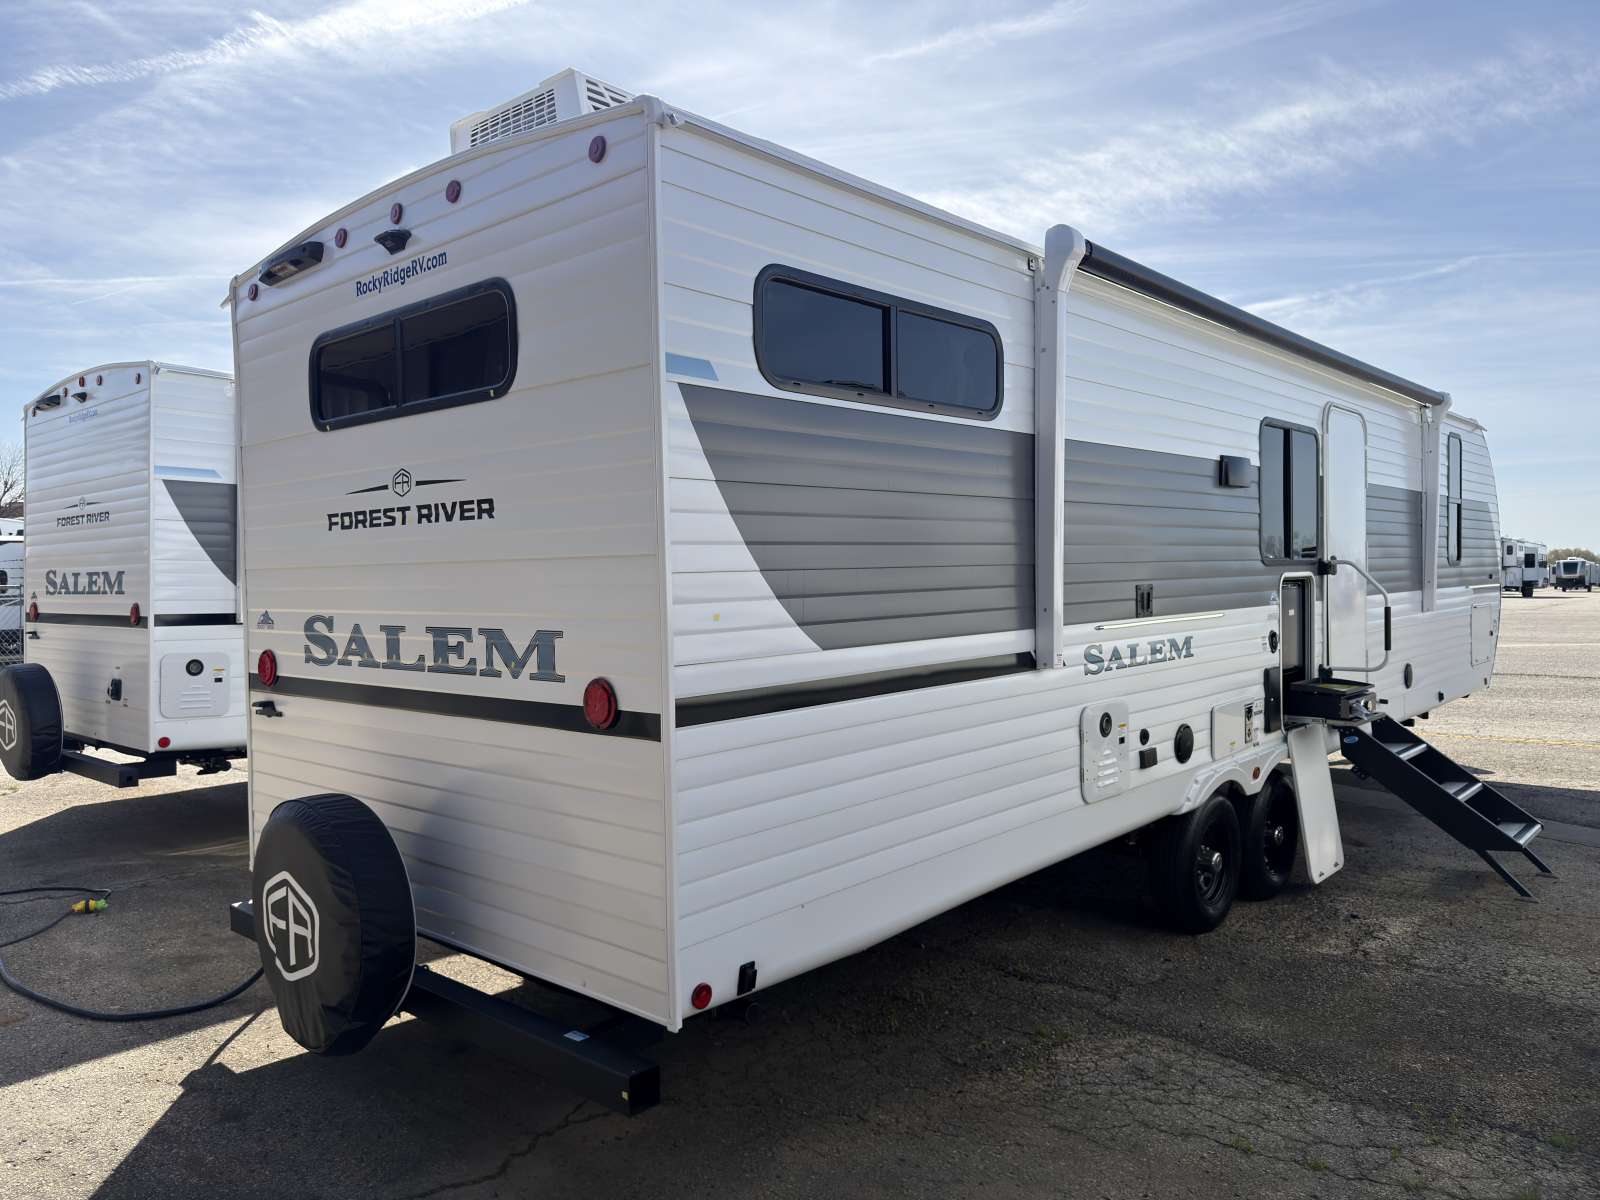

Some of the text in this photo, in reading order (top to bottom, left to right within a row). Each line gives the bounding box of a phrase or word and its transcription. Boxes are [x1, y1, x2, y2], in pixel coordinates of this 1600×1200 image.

[356, 251, 447, 296] RockyRidgeRV.com
[57, 511, 110, 528] FOREST RIVER
[327, 498, 495, 531] FOREST RIVER
[45, 569, 125, 595] SALEM
[304, 614, 566, 683] SALEM
[1084, 636, 1194, 675] SALEM
